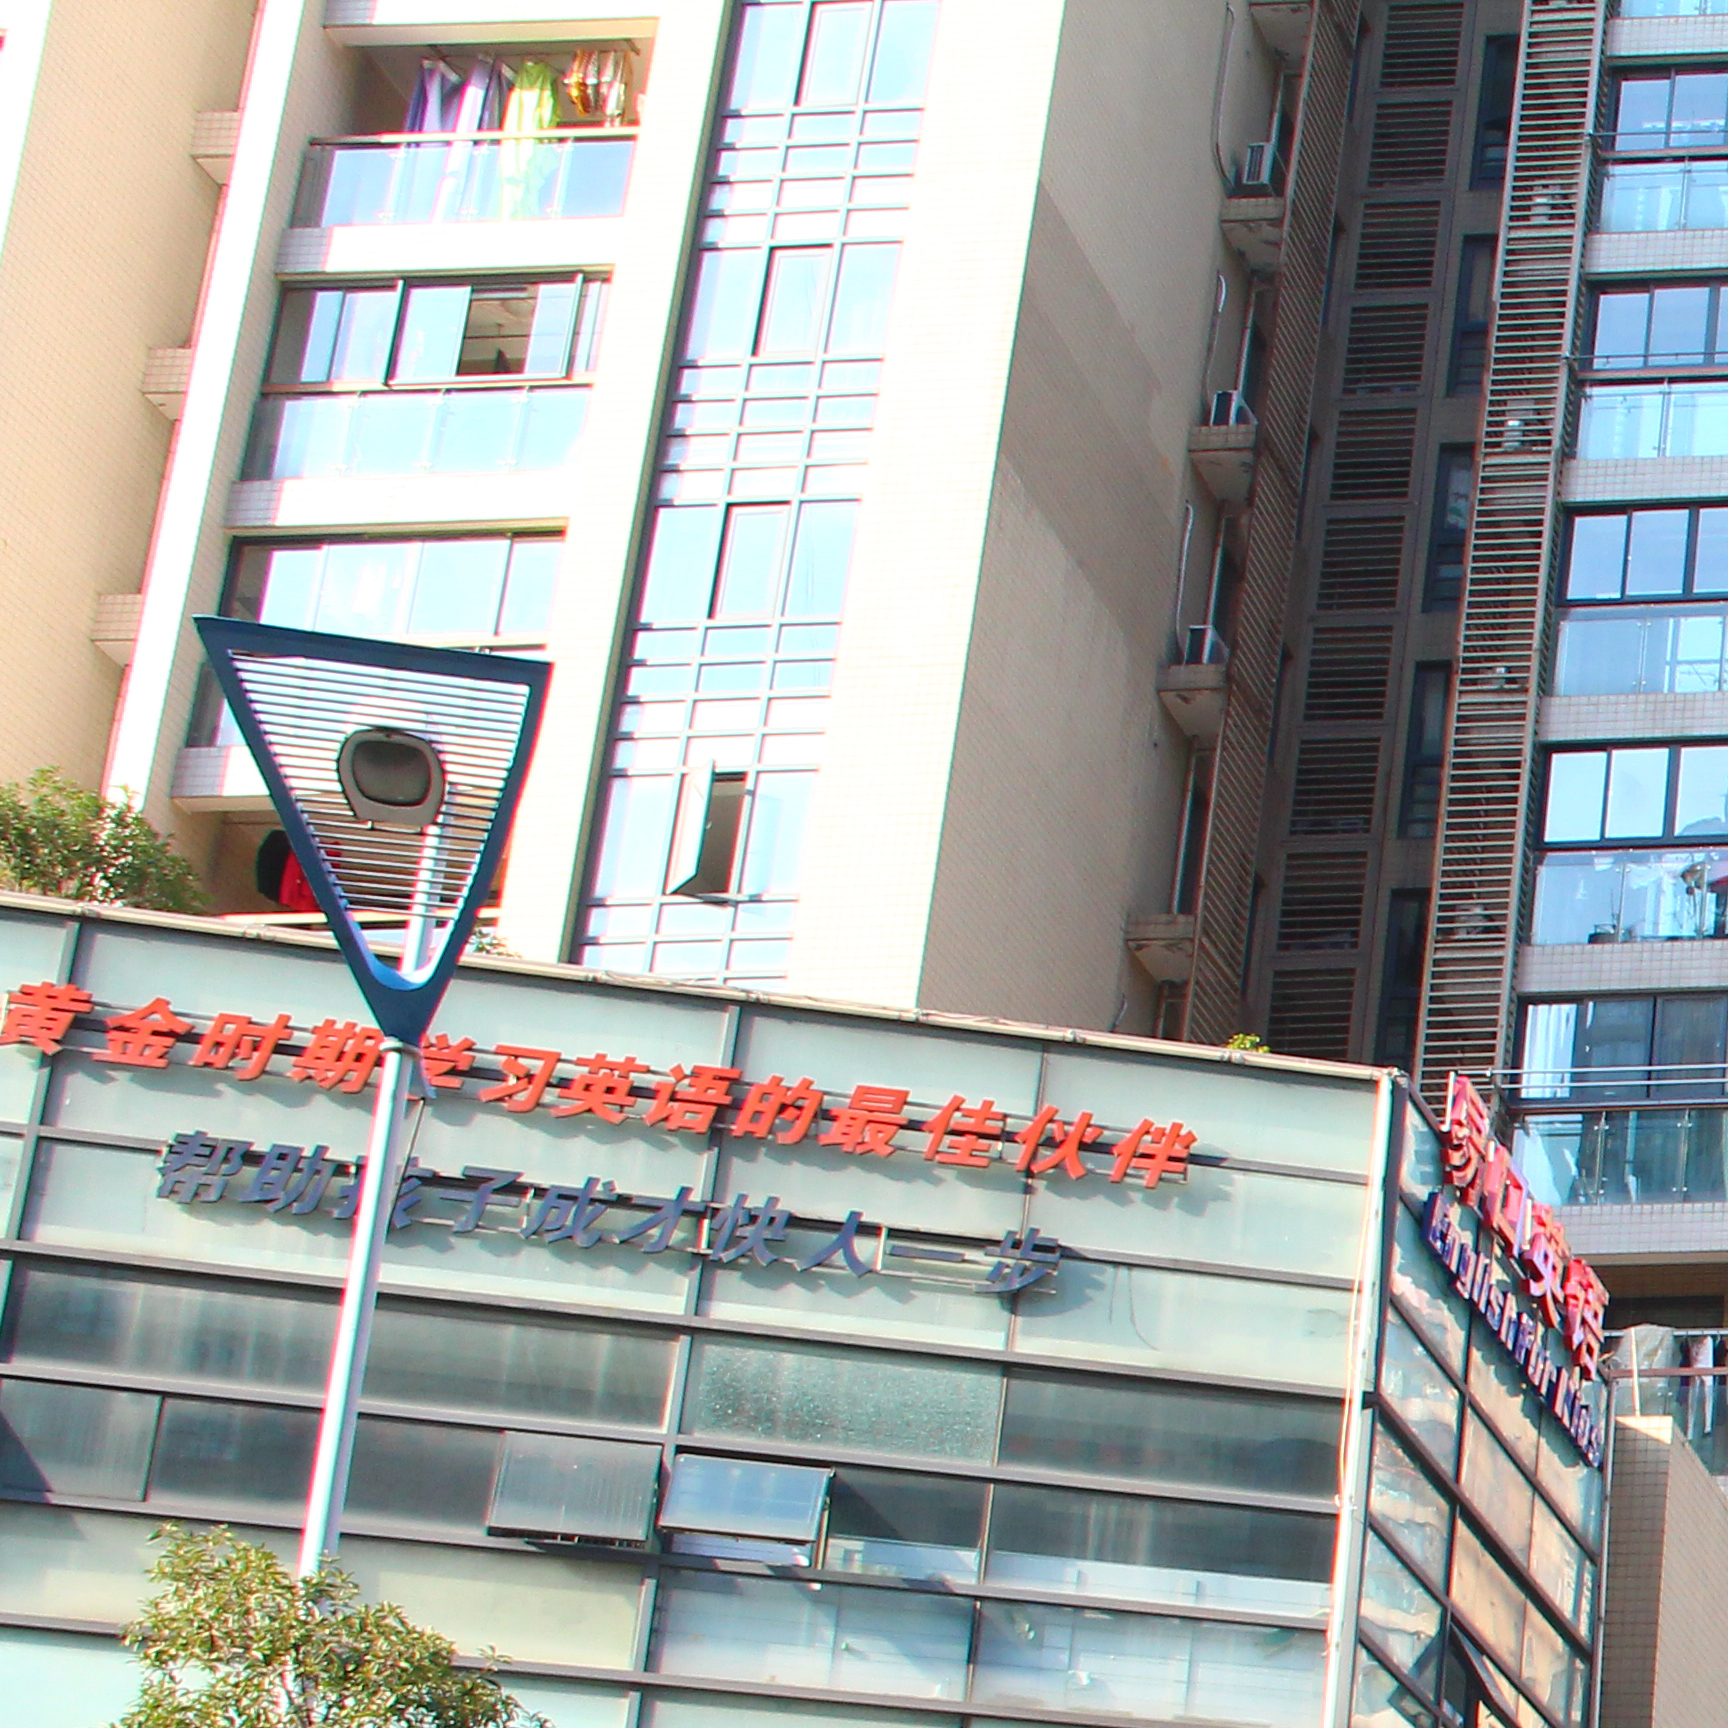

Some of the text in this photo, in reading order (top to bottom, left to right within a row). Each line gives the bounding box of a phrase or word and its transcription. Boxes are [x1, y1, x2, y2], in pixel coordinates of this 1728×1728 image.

[0, 981, 1198, 1189] 黄金时期学习英语的最佳伙伴
